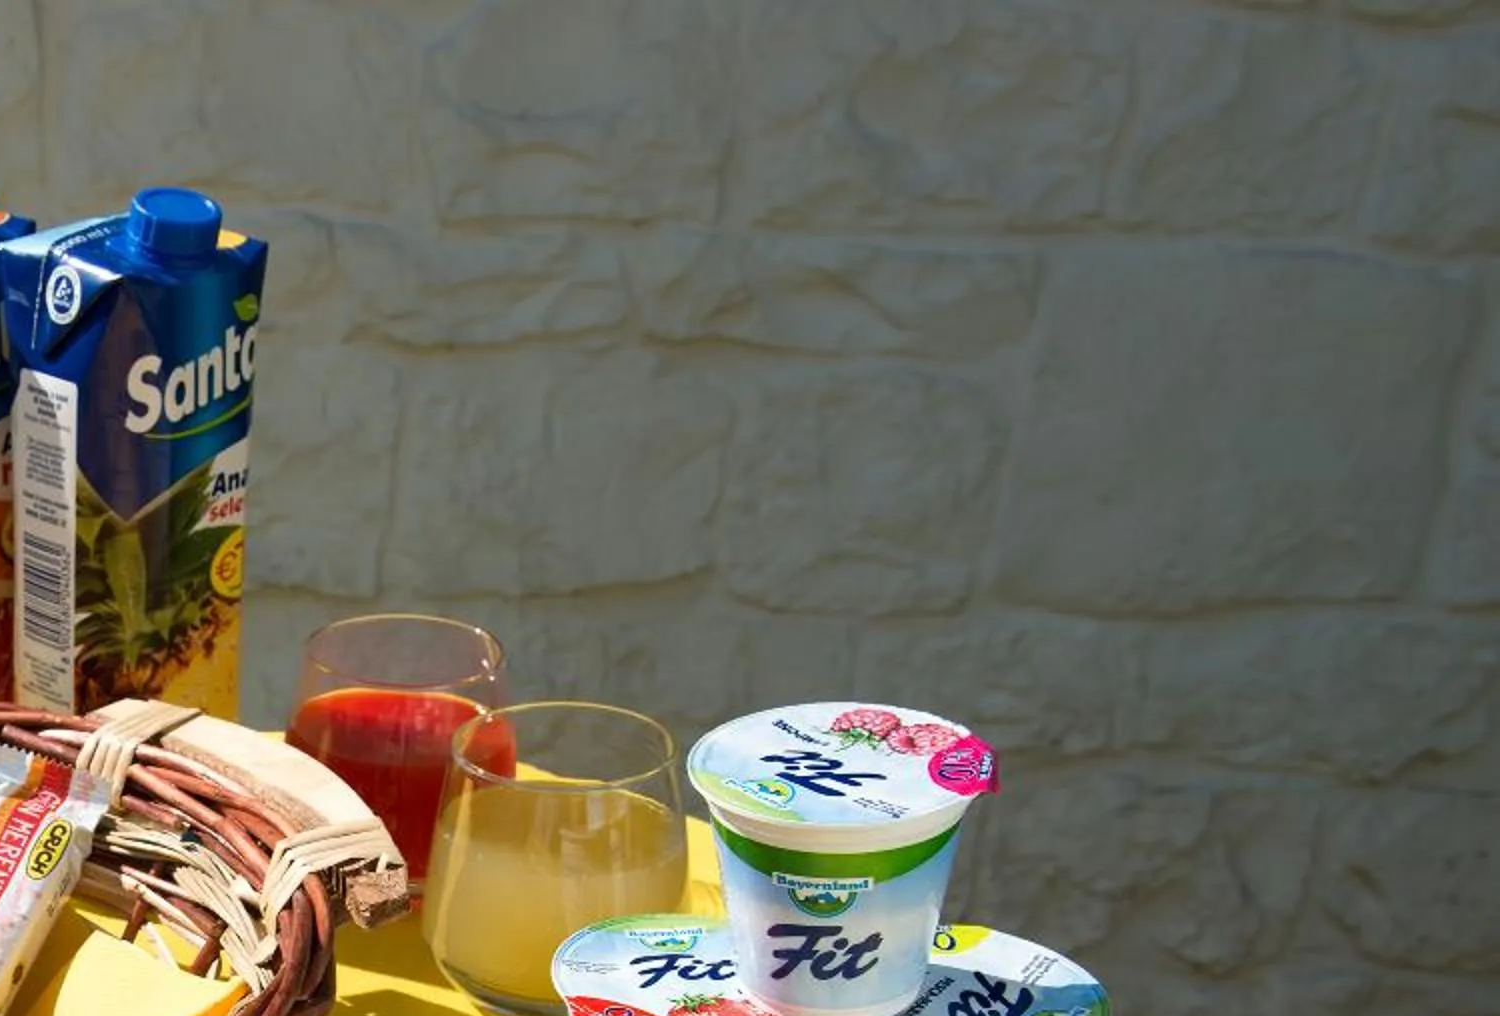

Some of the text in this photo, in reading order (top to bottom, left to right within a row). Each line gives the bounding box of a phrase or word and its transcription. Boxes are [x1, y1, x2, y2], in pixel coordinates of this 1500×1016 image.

[776, 876, 870, 892] Bayernland
[767, 923, 884, 981] Fit
[630, 953, 737, 989] Fit
